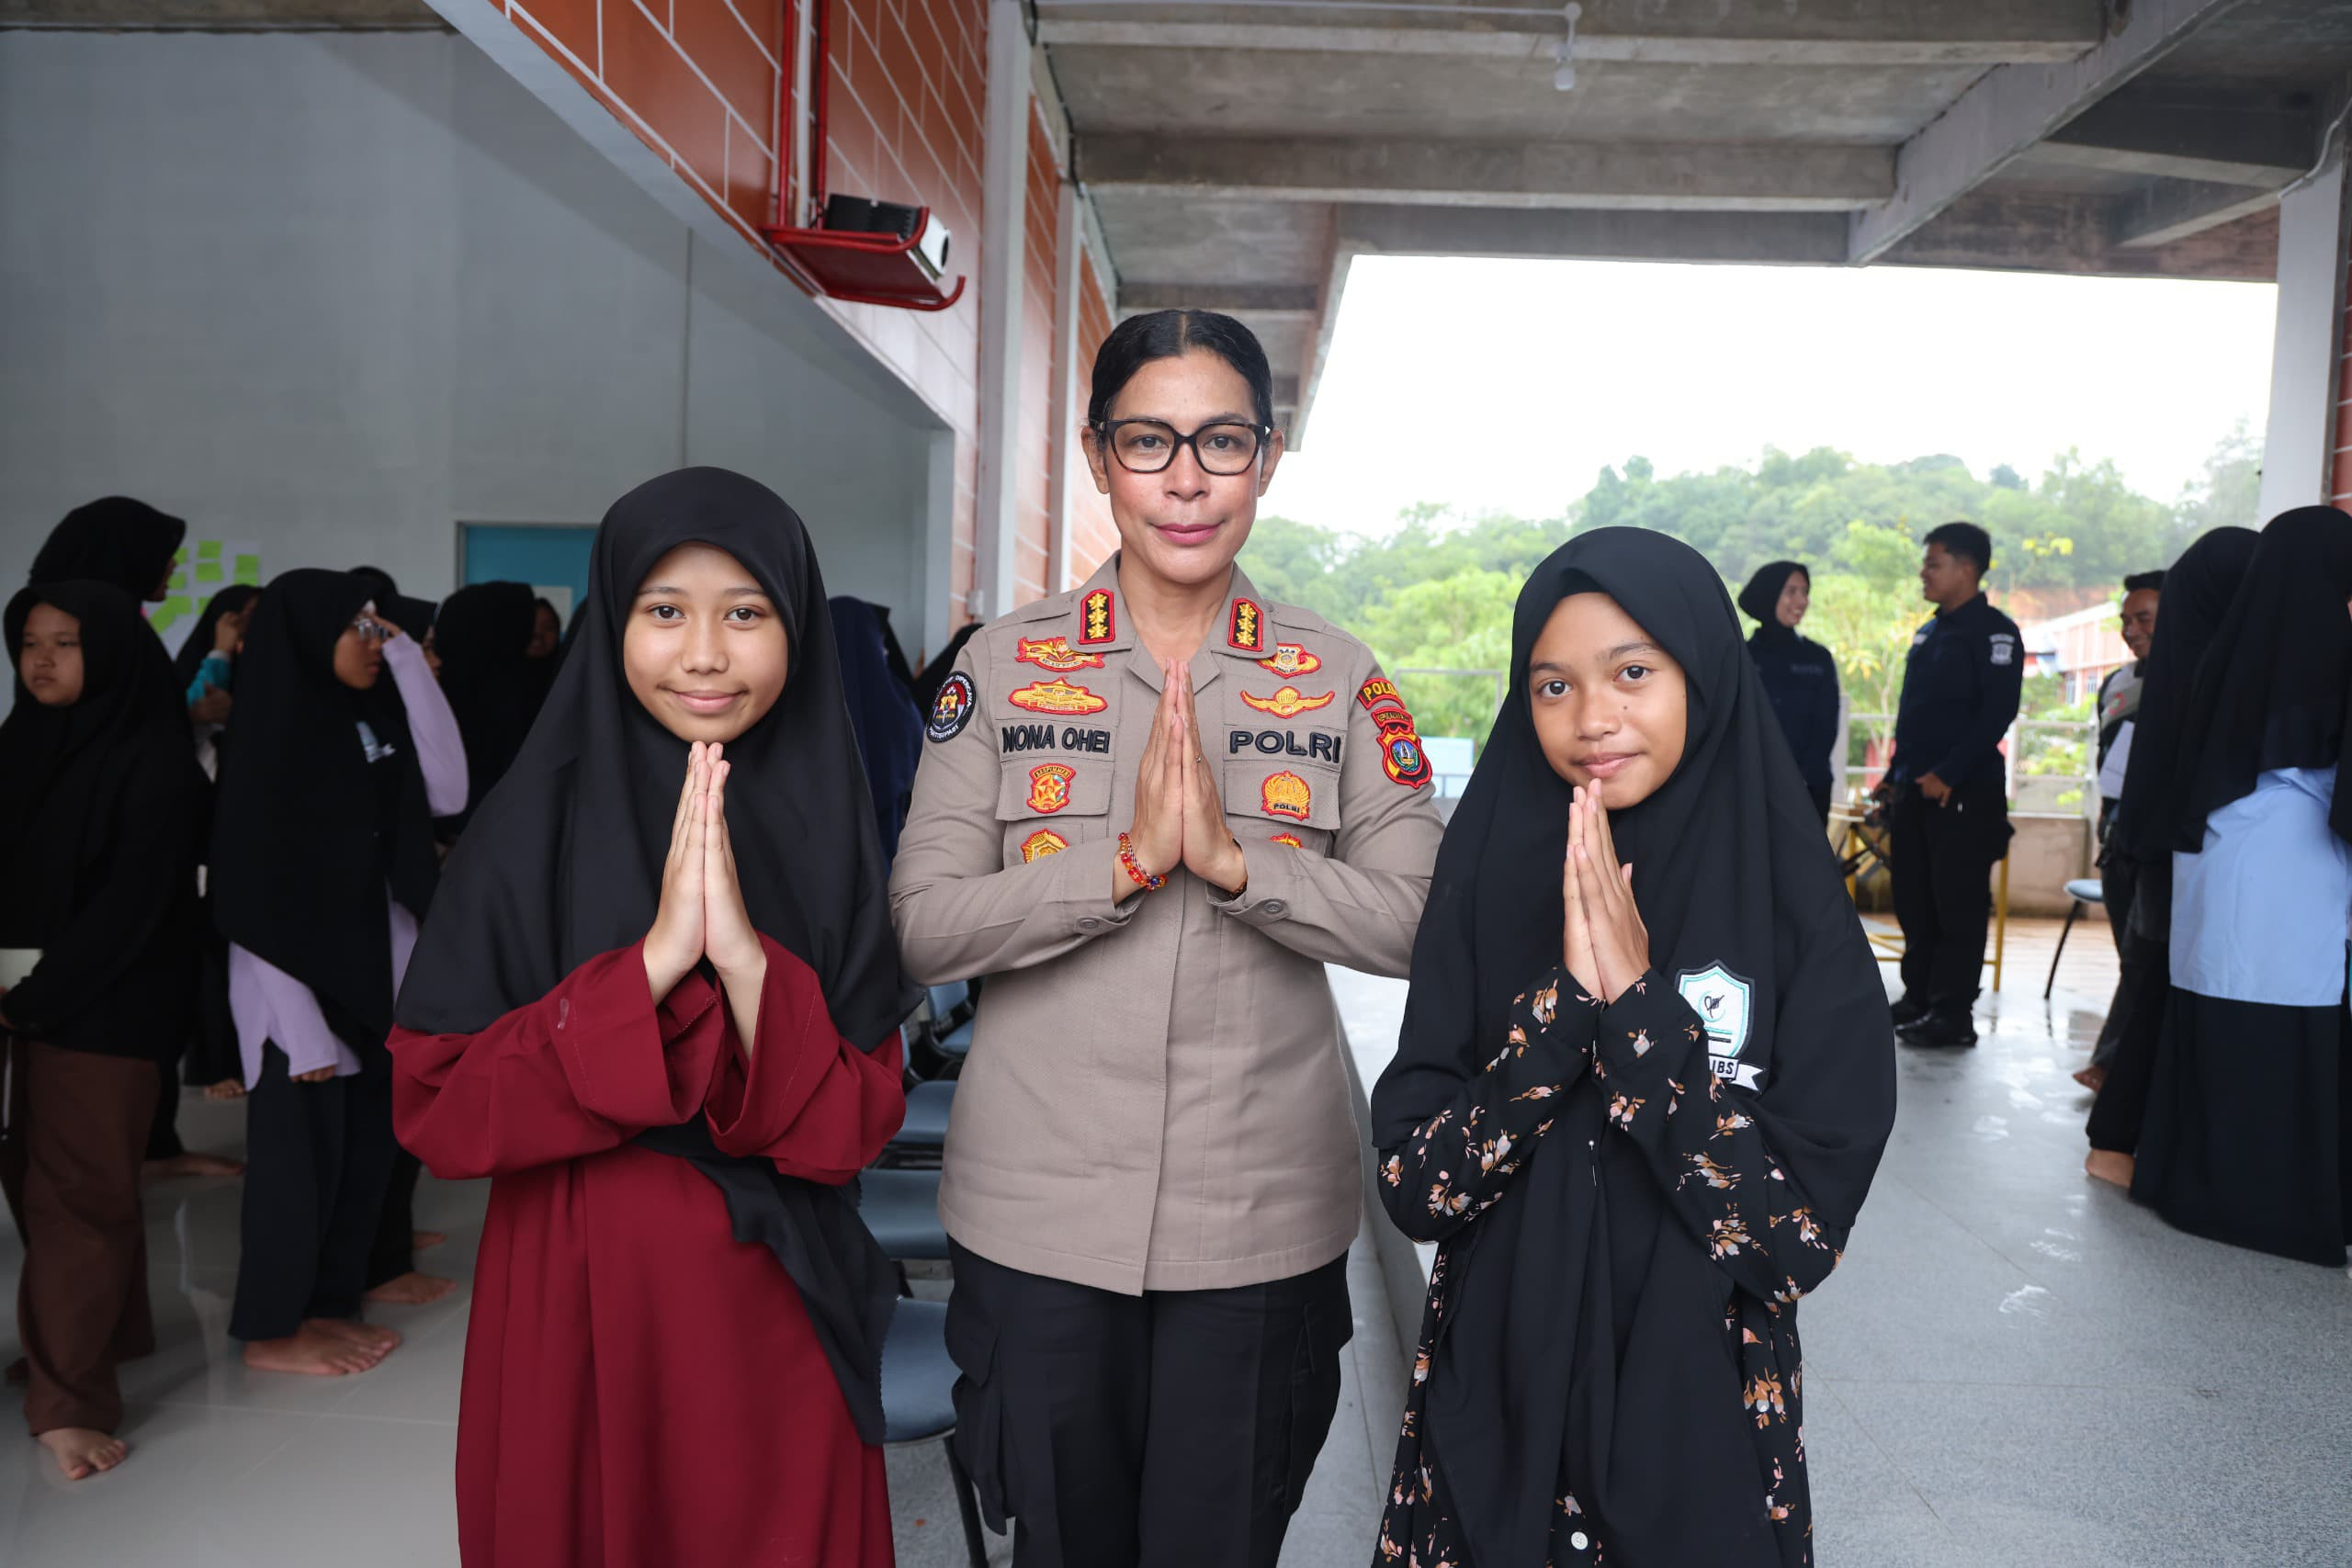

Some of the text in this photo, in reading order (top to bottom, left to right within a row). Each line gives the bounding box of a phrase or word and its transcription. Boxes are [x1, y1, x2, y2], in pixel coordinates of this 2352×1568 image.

[1002, 724, 1111, 754] NONA OHEI
[1229, 730, 1341, 763] POLRI
[1273, 803, 1301, 813] POLRI
